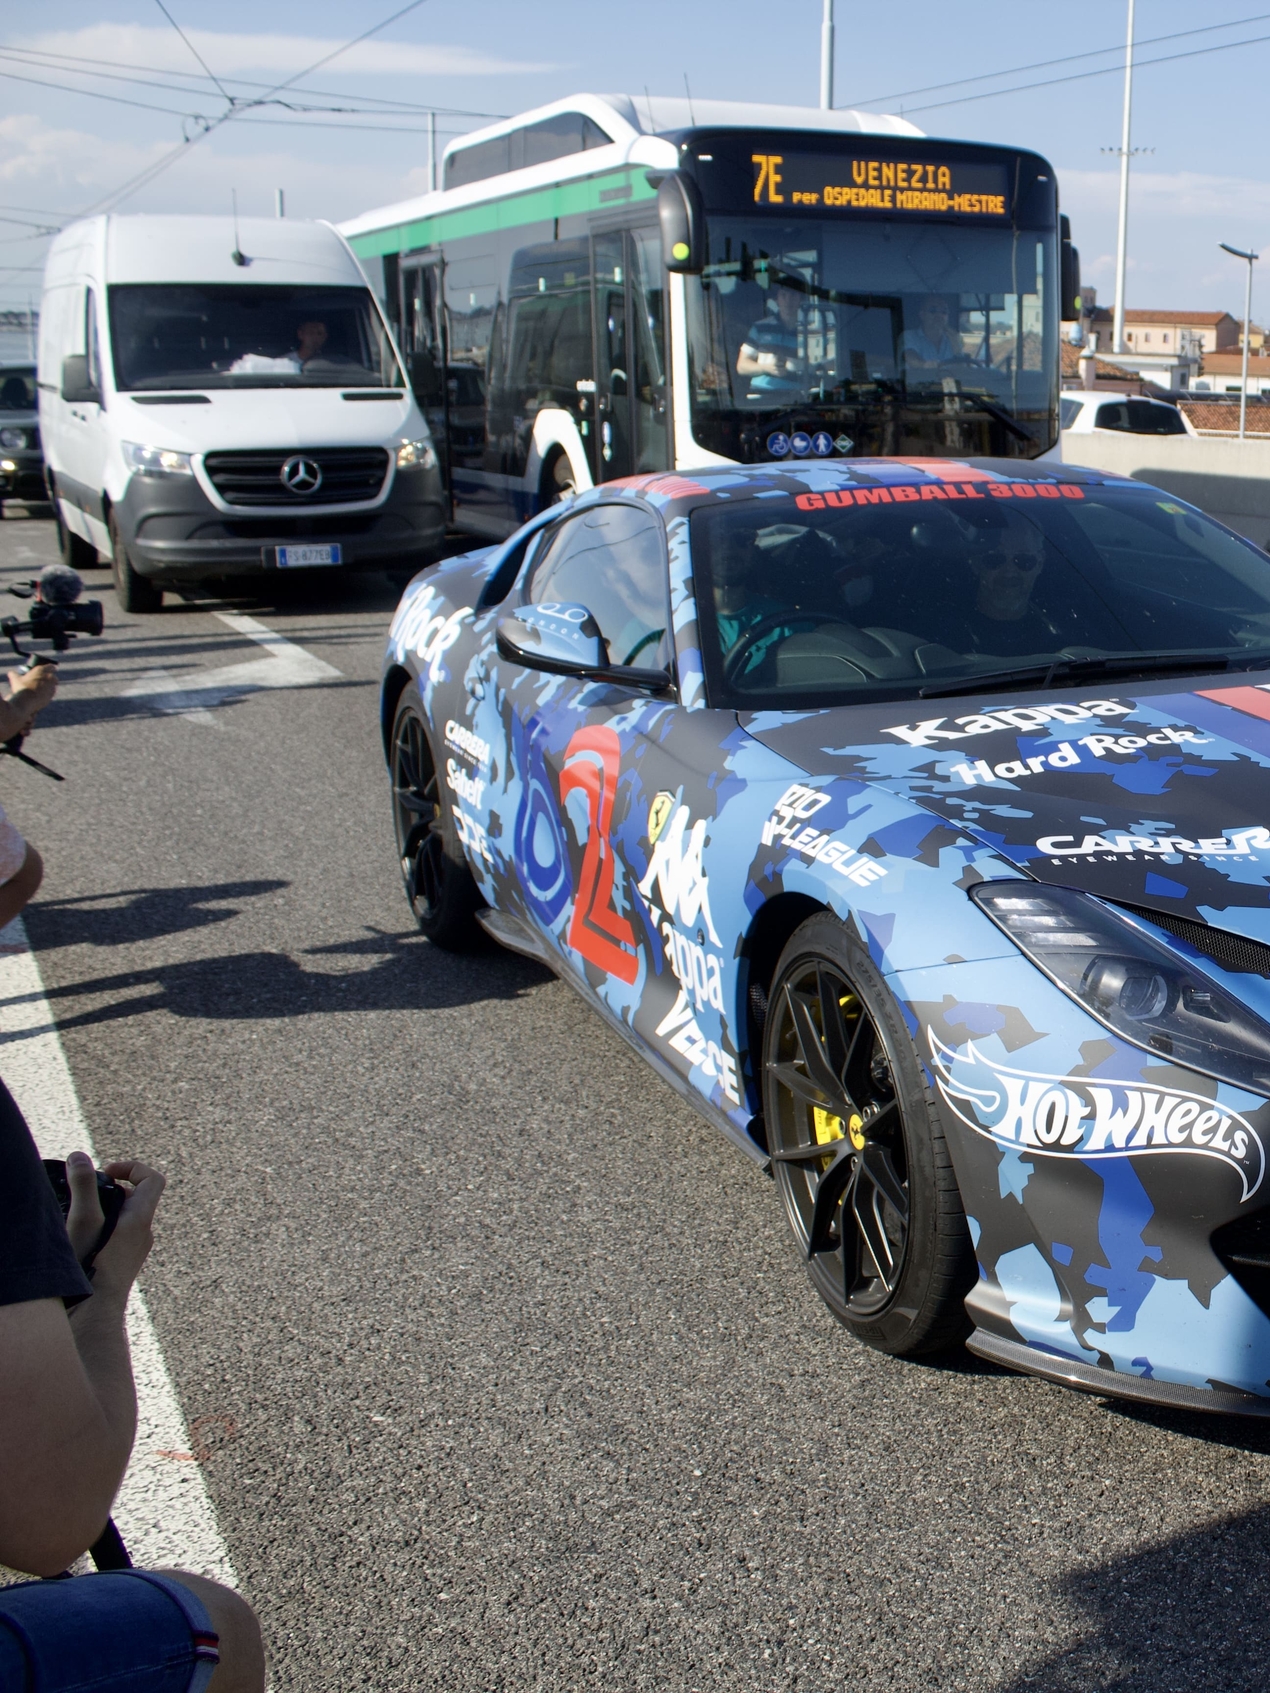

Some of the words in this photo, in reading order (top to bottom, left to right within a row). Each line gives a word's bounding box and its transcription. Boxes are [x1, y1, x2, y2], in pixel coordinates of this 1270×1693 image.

[752, 154, 783, 203] 7E
[852, 160, 951, 189] VENEZIA
[792, 191, 819, 204] per
[823, 186, 893, 208] OSPEDALE
[896, 189, 1005, 214] MIRANO-MESTRE
[795, 483, 985, 511] GUMBALL
[989, 483, 1085, 499] 3000
[517, 615, 580, 640] LONDON
[880, 699, 1139, 747] Kappa
[445, 719, 490, 765] CARRERA
[950, 742, 1081, 785] Hard
[1078, 726, 1209, 757] Rock
[446, 758, 487, 810] Sabelt
[1051, 853, 1170, 866] EYEWEAR
[1188, 853, 1260, 862] SINCE
